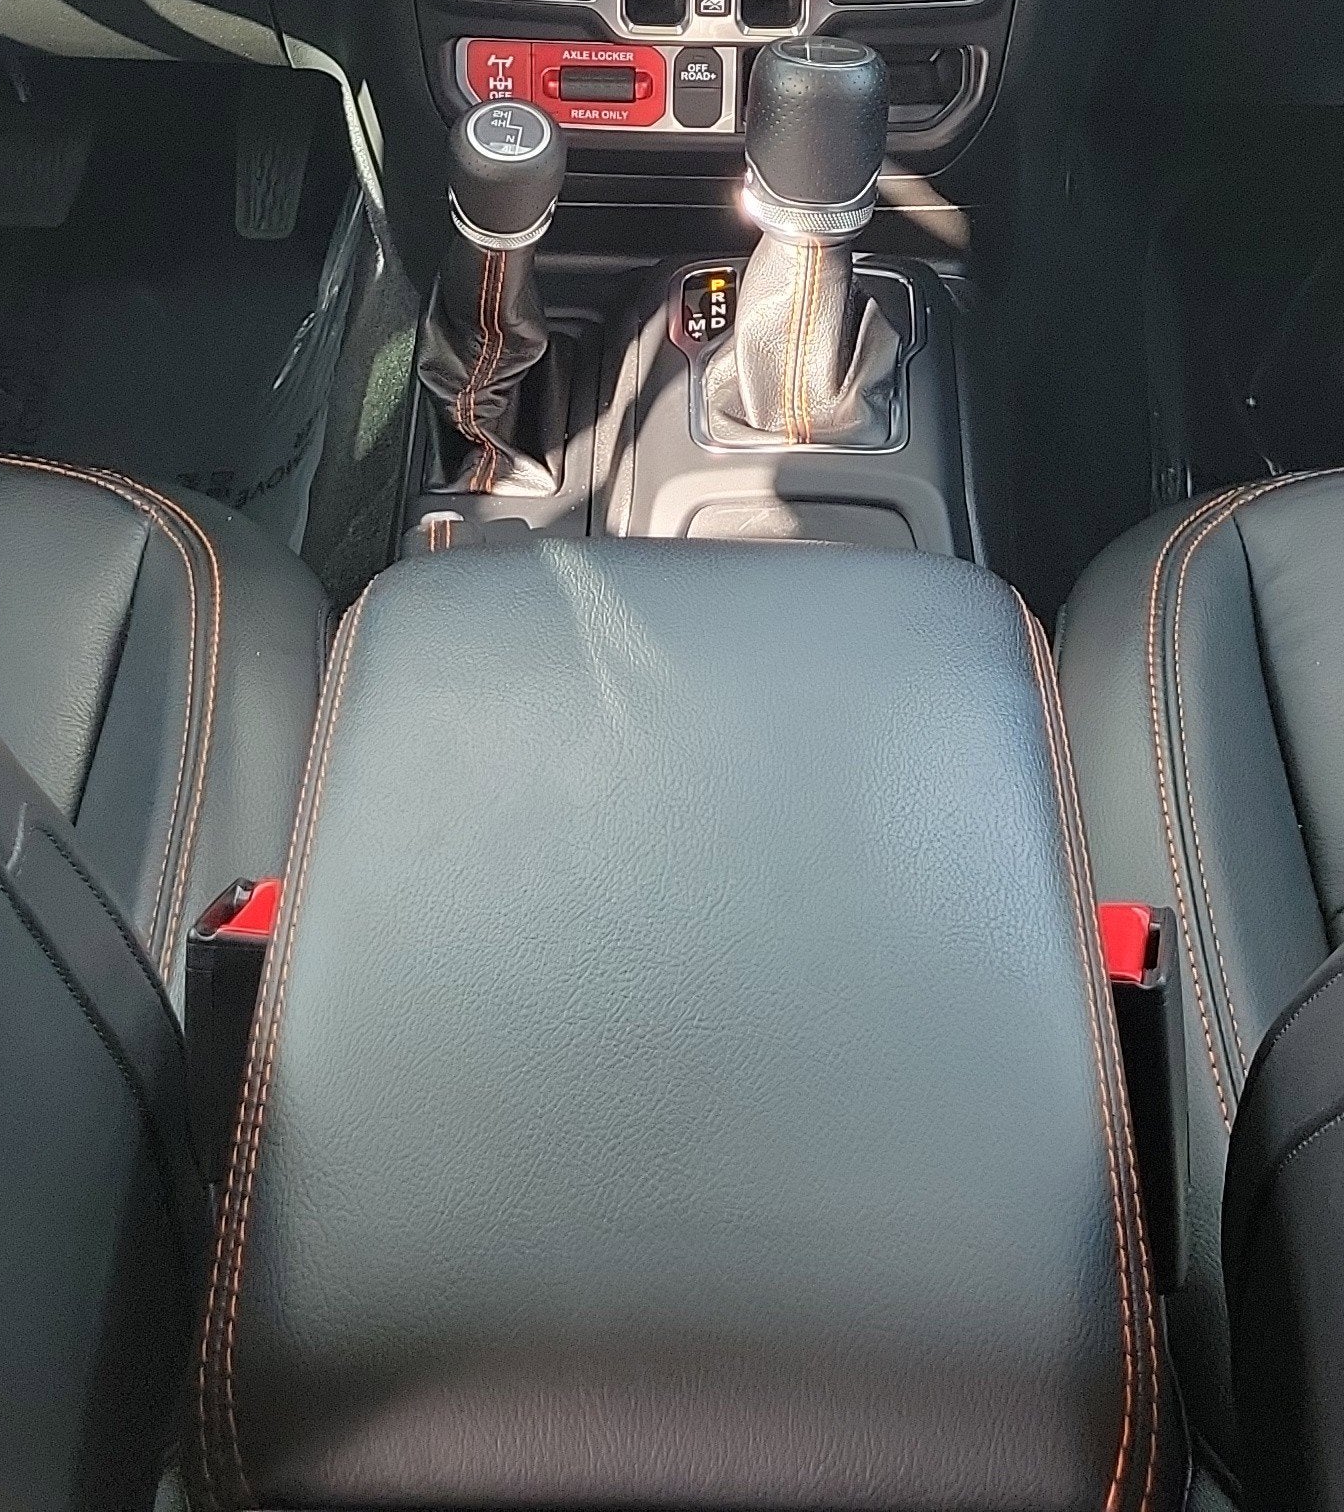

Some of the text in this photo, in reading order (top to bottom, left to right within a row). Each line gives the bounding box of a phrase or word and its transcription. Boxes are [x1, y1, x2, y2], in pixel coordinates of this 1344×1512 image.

[562, 50, 634, 61] AXLE LOCKER
[687, 63, 709, 72] OFF
[492, 110, 508, 118] 2H
[571, 109, 629, 120] REAR ONLY
[491, 119, 507, 127] 4H
[506, 135, 515, 143] N
[711, 278, 725, 291] P
[711, 291, 726, 303] R
[711, 304, 726, 316] N
[710, 317, 726, 329] D
